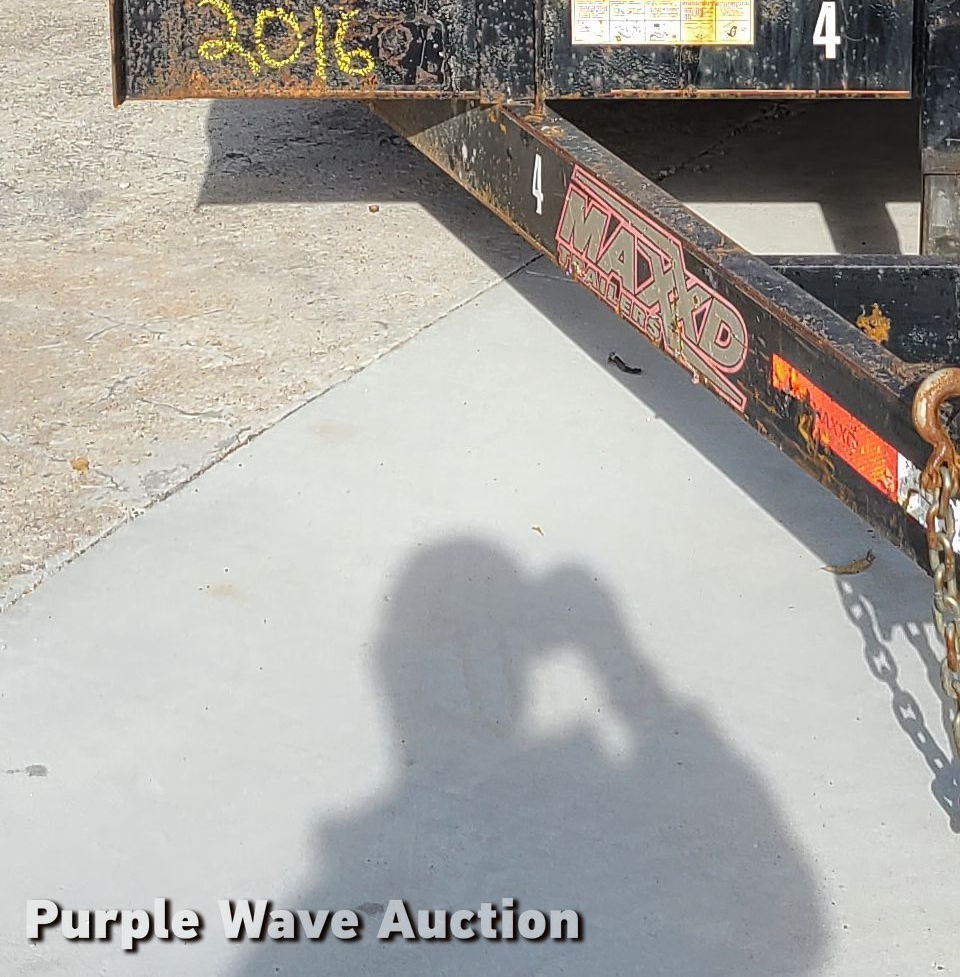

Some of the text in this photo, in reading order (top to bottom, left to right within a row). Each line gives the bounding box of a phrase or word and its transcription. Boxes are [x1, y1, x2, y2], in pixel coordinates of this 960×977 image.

[812, 1, 841, 59] 4
[532, 153, 543, 215] 4
[556, 167, 748, 400] MAXXD
